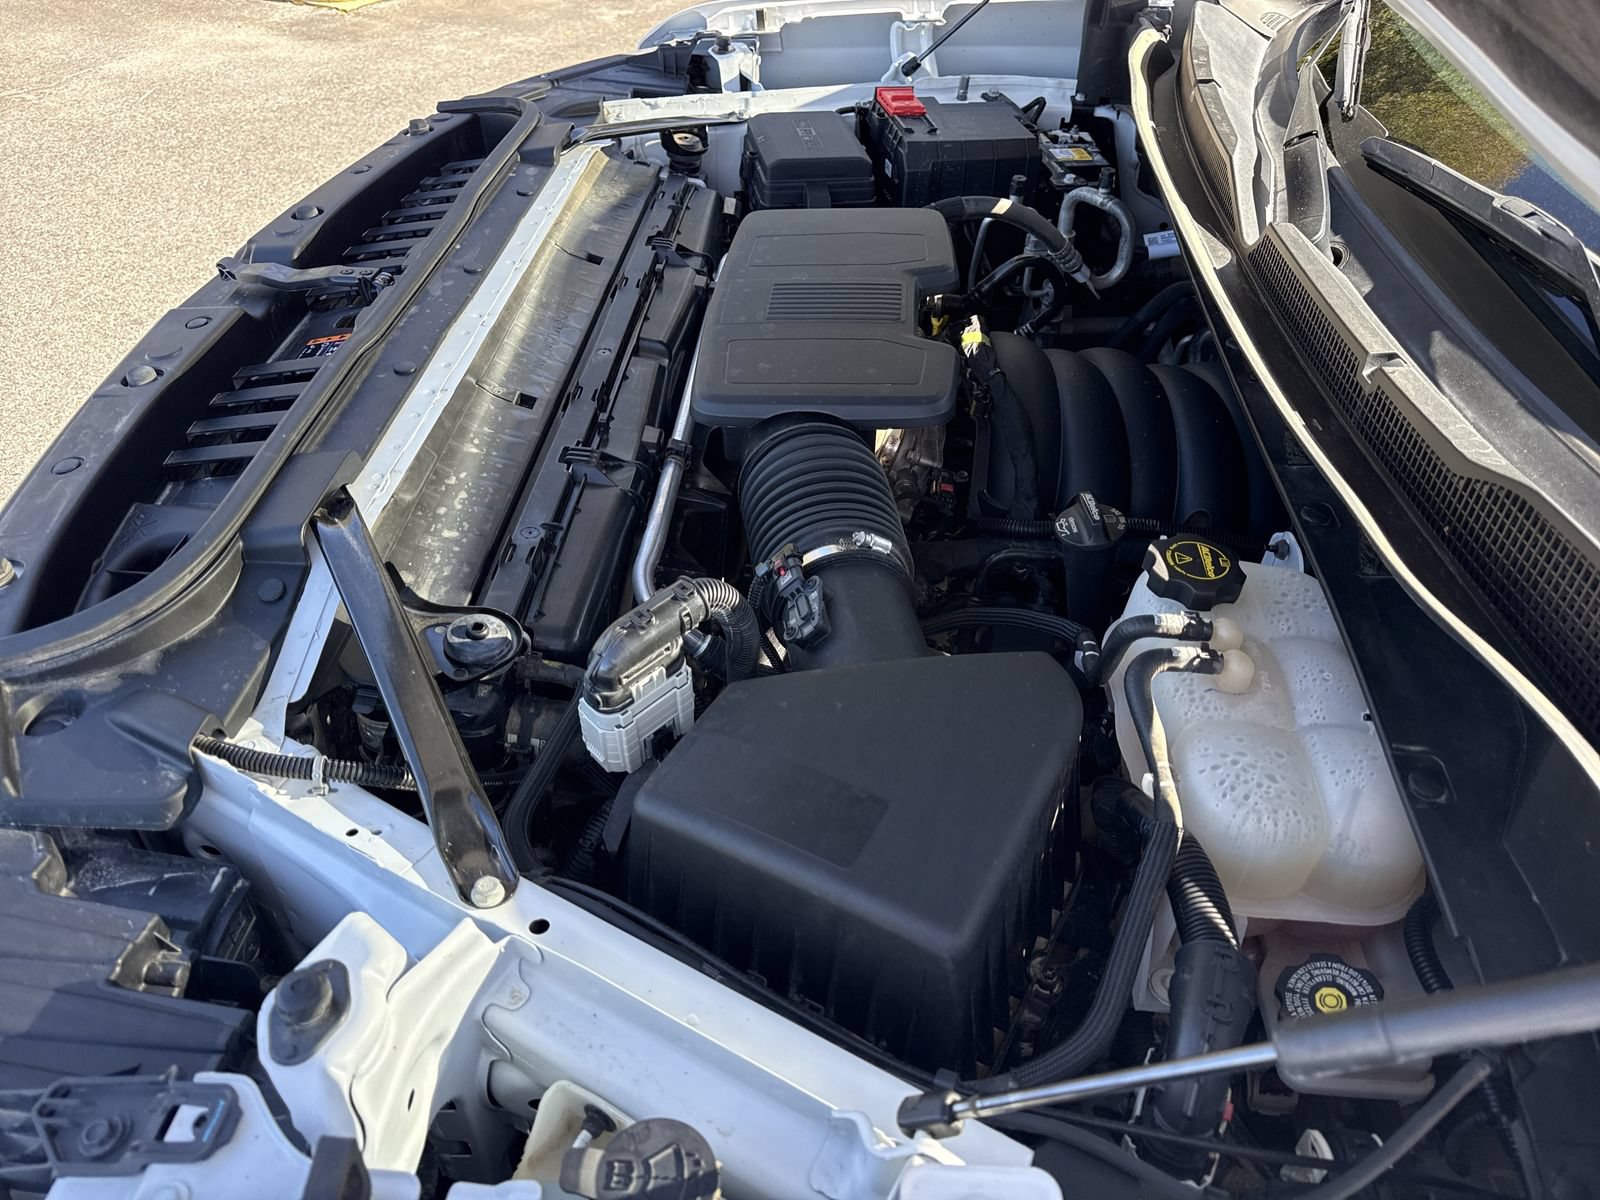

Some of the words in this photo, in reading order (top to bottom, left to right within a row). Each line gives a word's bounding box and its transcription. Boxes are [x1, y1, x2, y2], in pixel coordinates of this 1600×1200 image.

[1200, 546, 1215, 578] ACDelco
[1332, 962, 1348, 972] FROM
[1301, 972, 1311, 981] USE
[1339, 971, 1359, 986] BEFORE
[1294, 979, 1304, 992] ONLY
